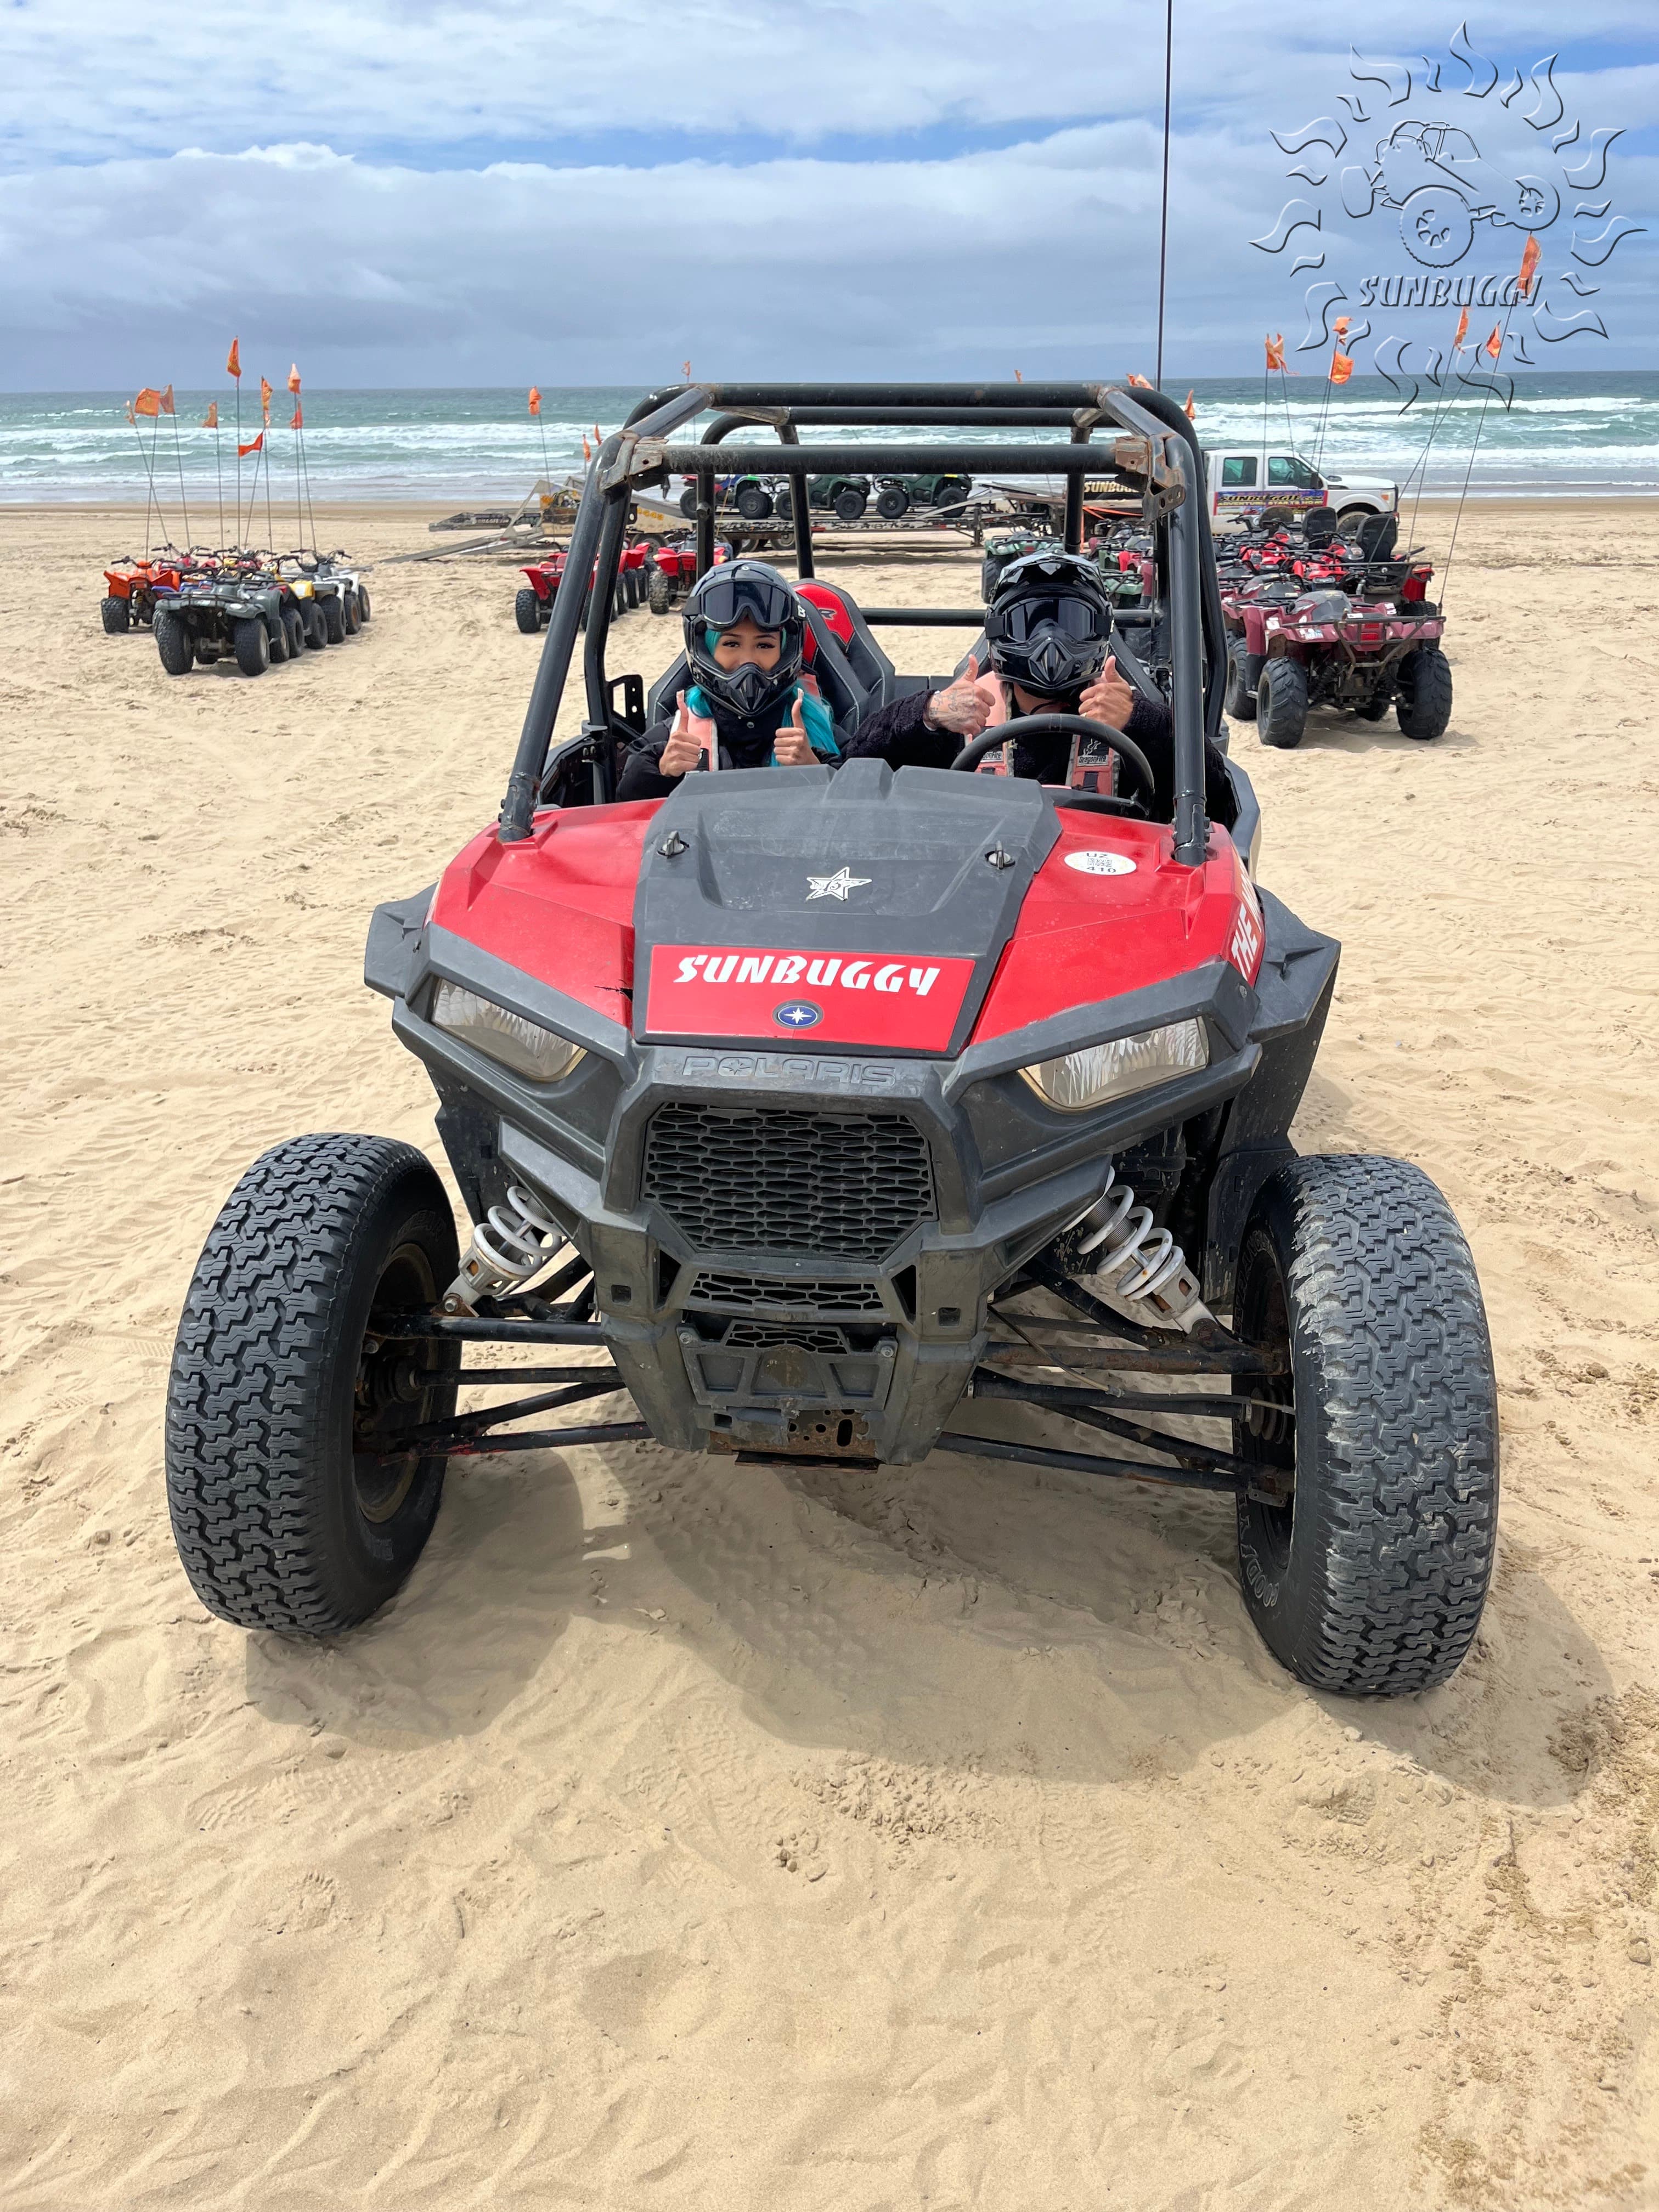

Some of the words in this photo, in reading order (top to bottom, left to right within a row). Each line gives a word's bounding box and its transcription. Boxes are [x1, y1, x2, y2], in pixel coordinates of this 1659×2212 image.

[1084, 481, 1139, 493] SUNBU
[673, 955, 940, 996] SUNBUGGY
[682, 1056, 895, 1086] POLARIS
